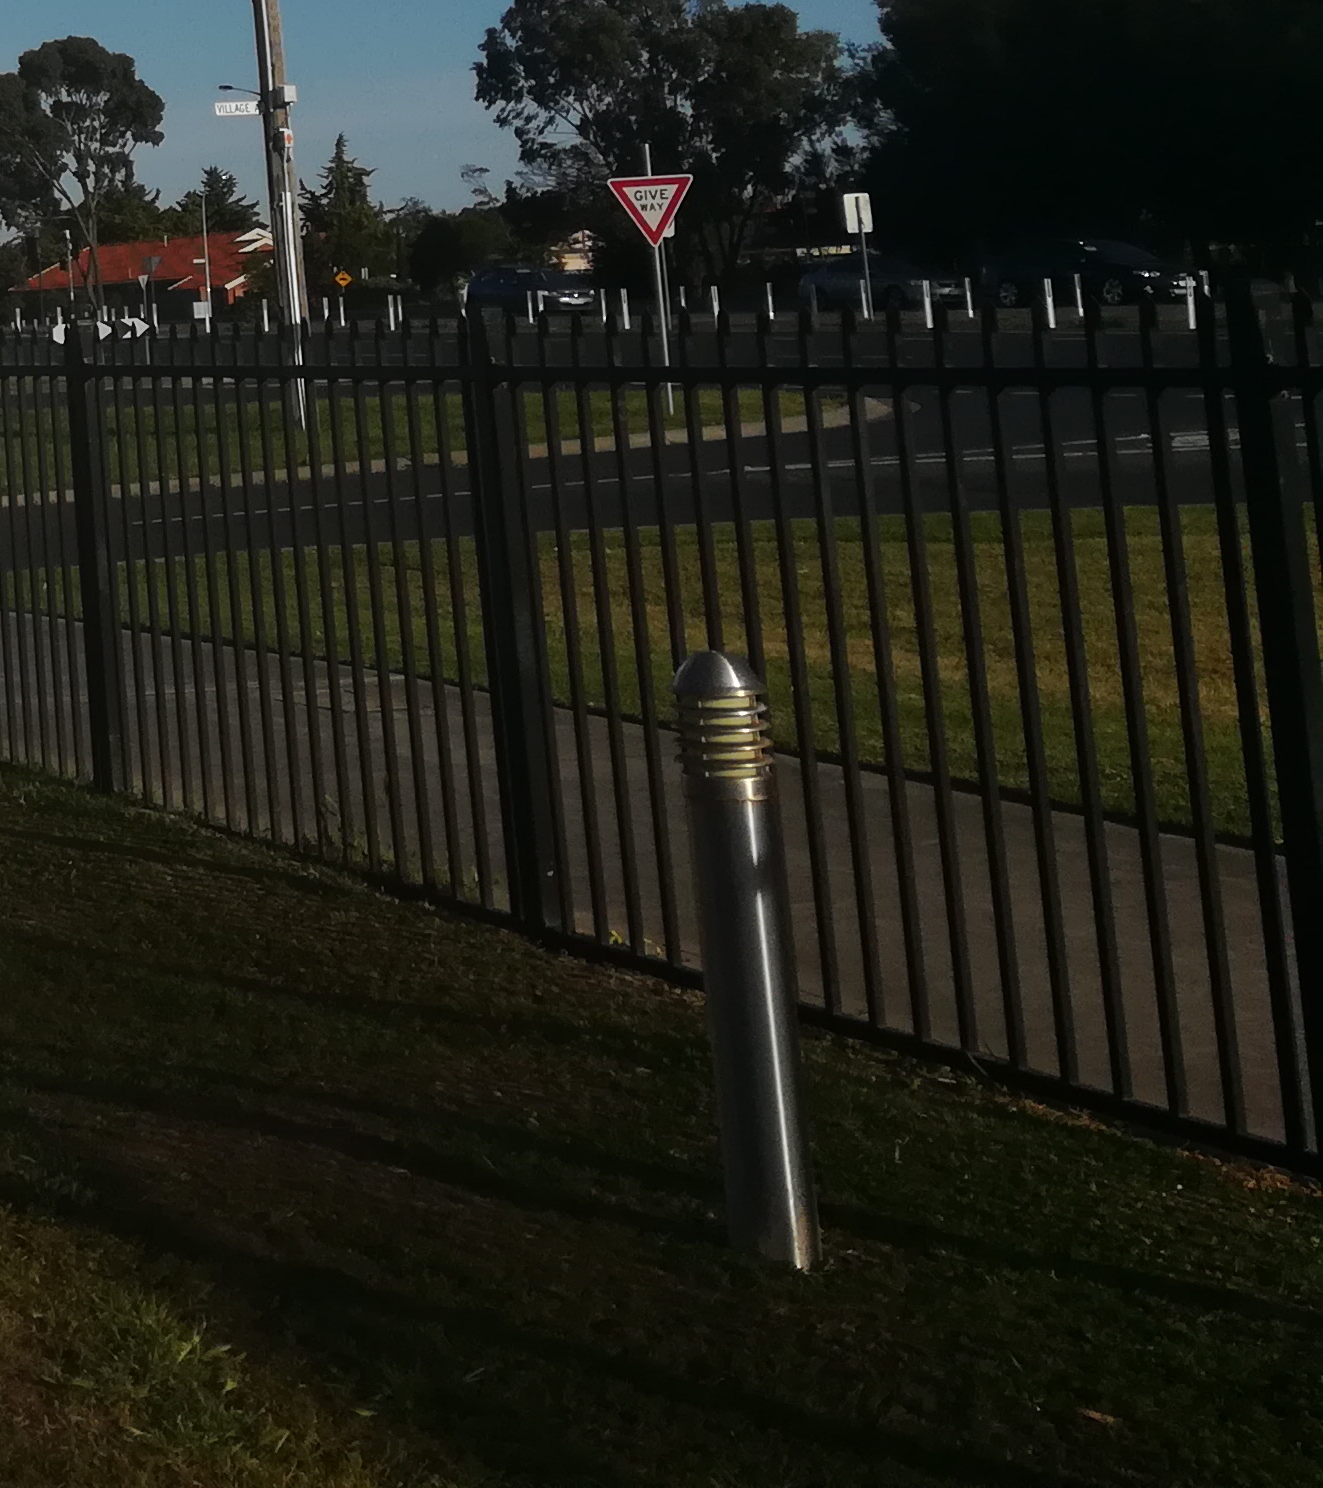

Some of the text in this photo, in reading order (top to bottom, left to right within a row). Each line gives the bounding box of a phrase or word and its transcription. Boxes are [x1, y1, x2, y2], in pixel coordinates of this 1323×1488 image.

[216, 103, 251, 114] VILLAGE
[634, 189, 669, 201] GIVE
[640, 203, 664, 211] WAY
